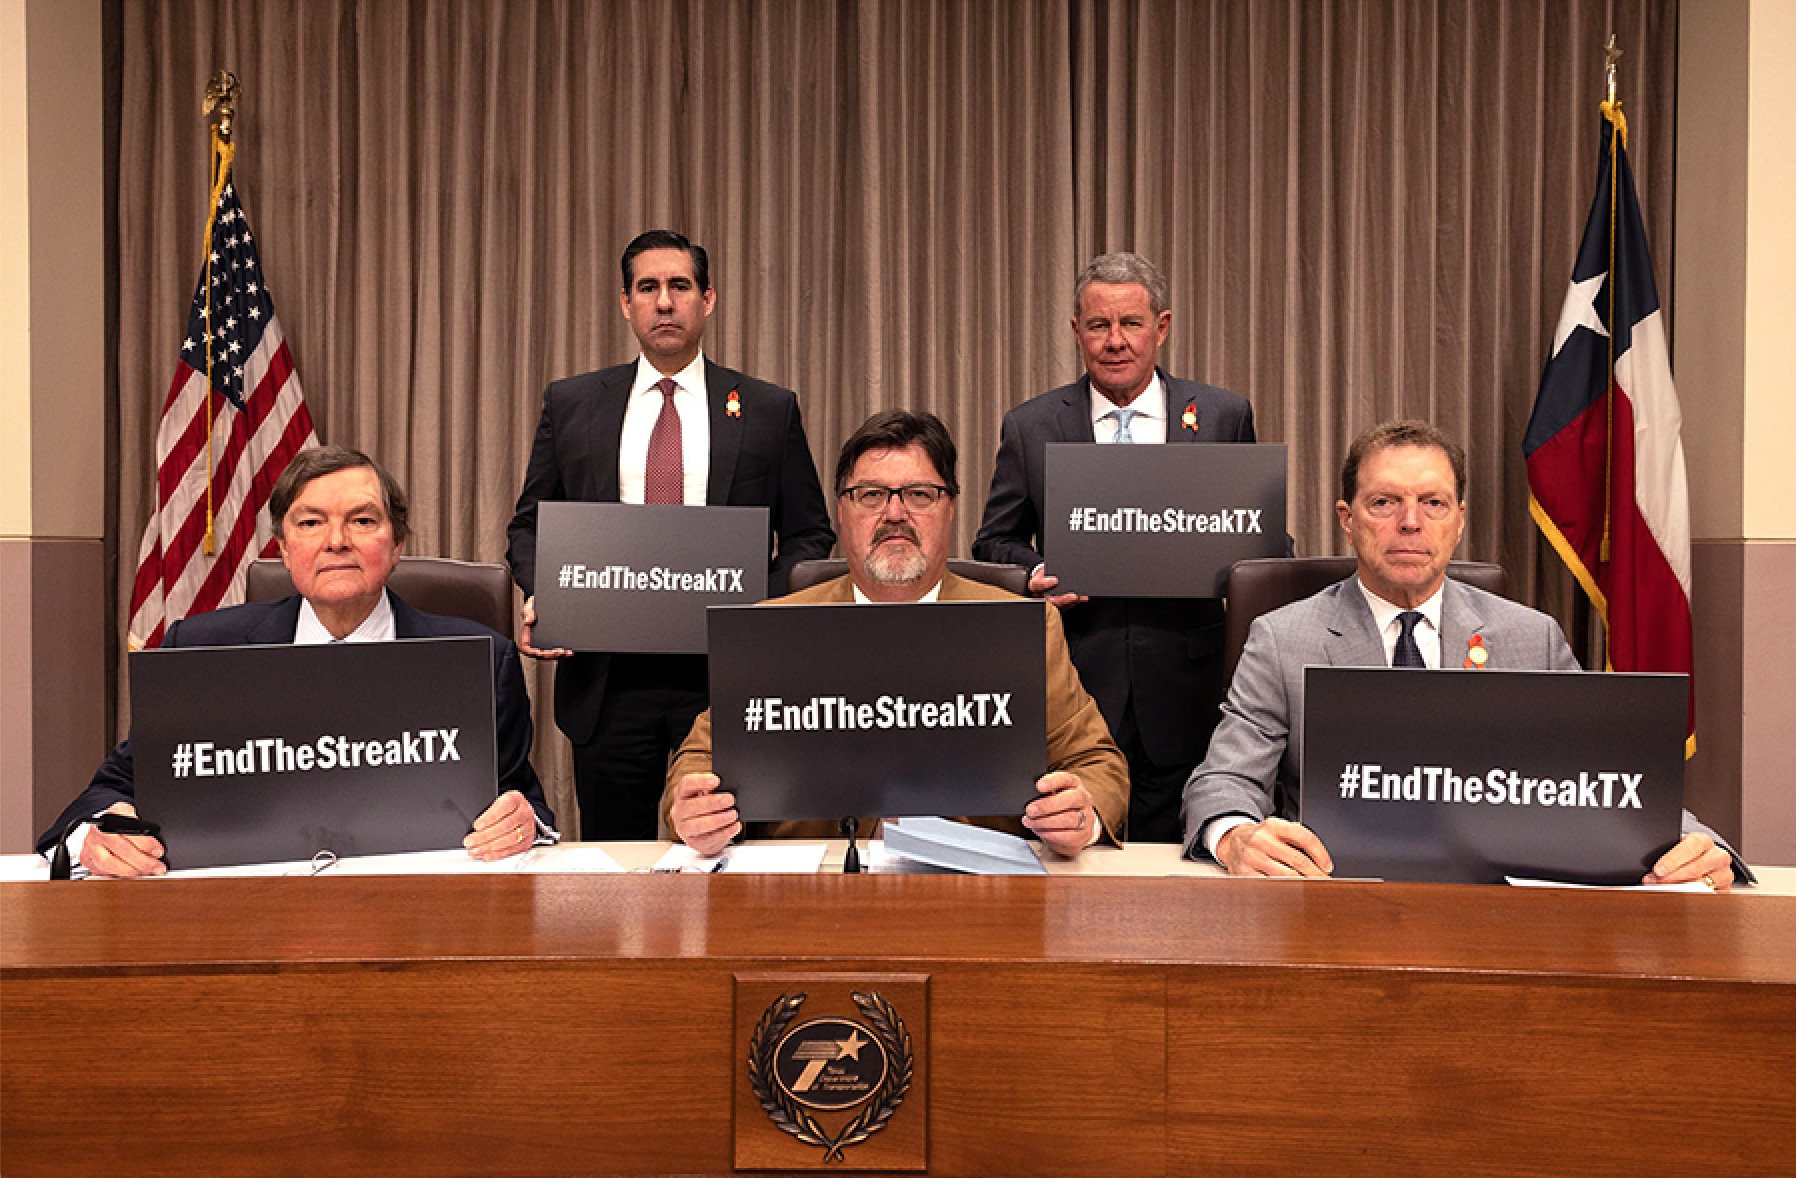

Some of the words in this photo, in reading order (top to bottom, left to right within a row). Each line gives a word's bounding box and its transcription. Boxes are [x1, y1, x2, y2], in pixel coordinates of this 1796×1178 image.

[1069, 508, 1263, 534] #EndTheStreakTX
[558, 564, 743, 593] #EndTheStreakTX
[745, 694, 1012, 731] #EndTheStreakTX
[172, 728, 460, 778] #EndTheStreakTX
[1340, 764, 1643, 809] #EndTheStreakTX
